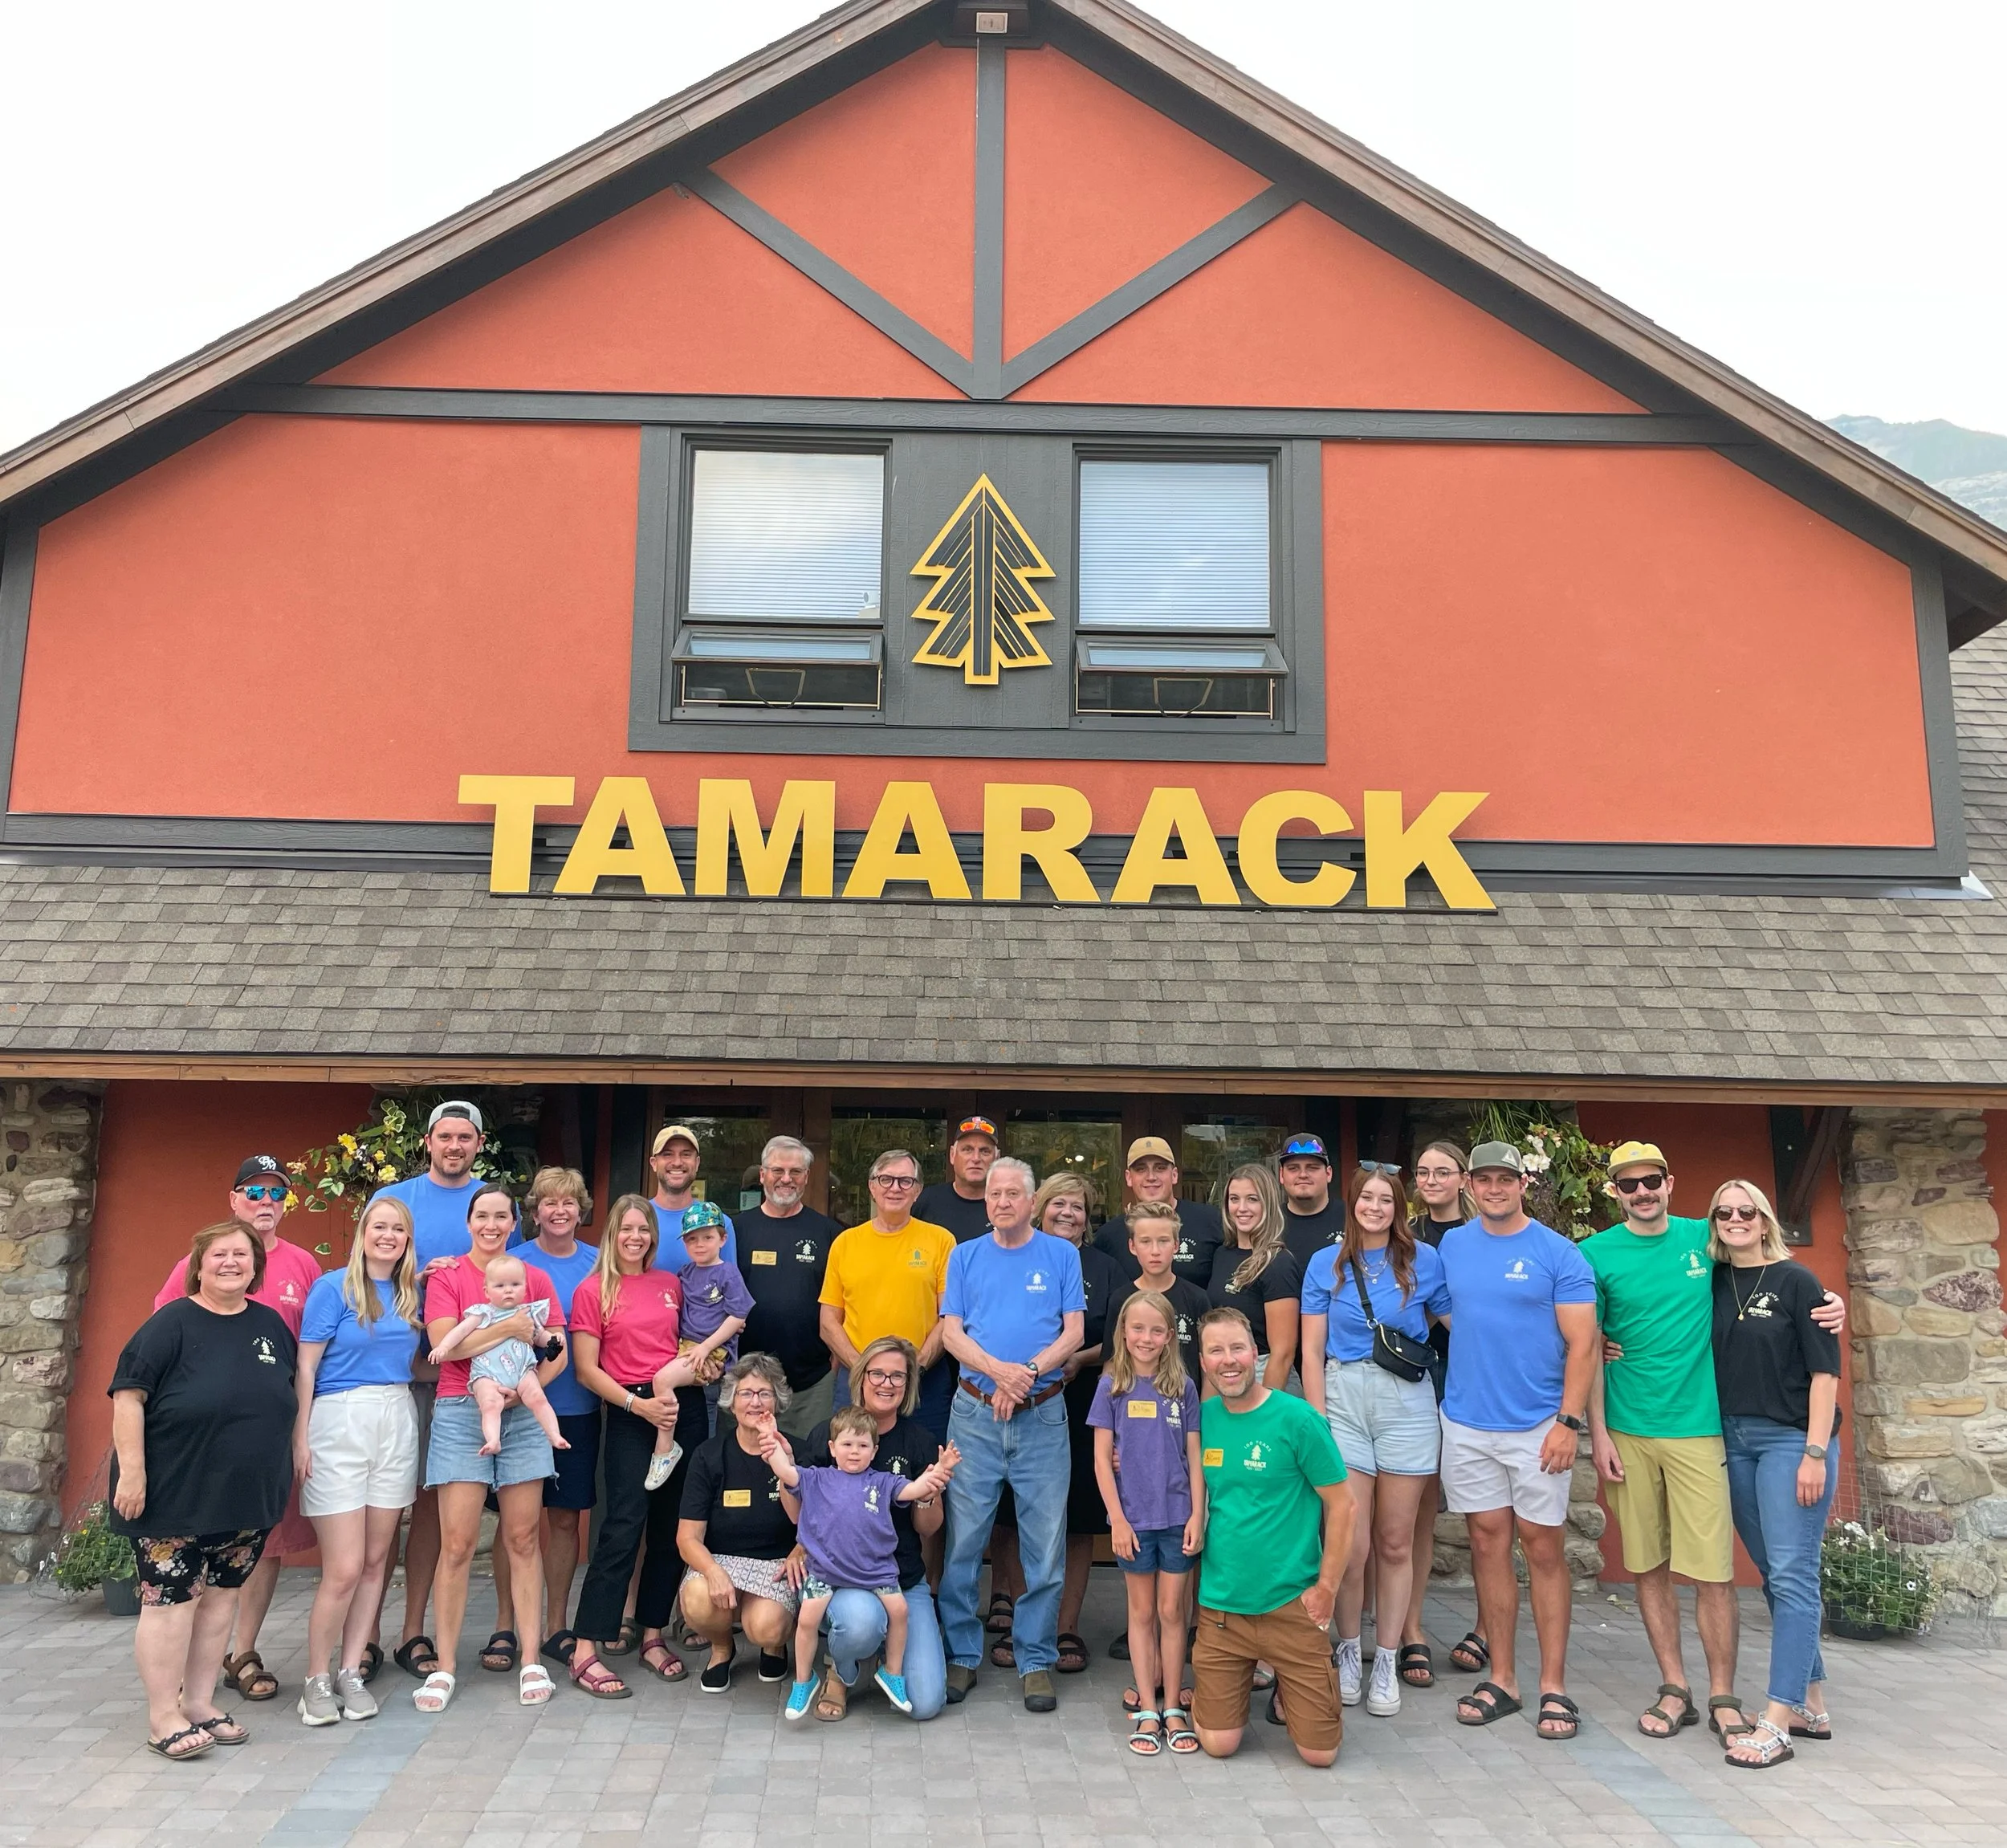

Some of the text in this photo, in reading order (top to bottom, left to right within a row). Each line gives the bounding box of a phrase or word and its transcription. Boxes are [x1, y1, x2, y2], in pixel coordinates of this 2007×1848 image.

[458, 775, 1496, 910] TAMARACK
[1181, 1237, 1197, 1247] YEARS
[1686, 1267, 1708, 1276] TAMARACK
[1765, 1292, 1780, 1302] YEARS
[1747, 1307, 1773, 1317] TAMARACK
[1179, 1313, 1194, 1325] YEARS
[1256, 1440, 1272, 1452] YEARS
[1244, 1459, 1267, 1468] TAMARACK
